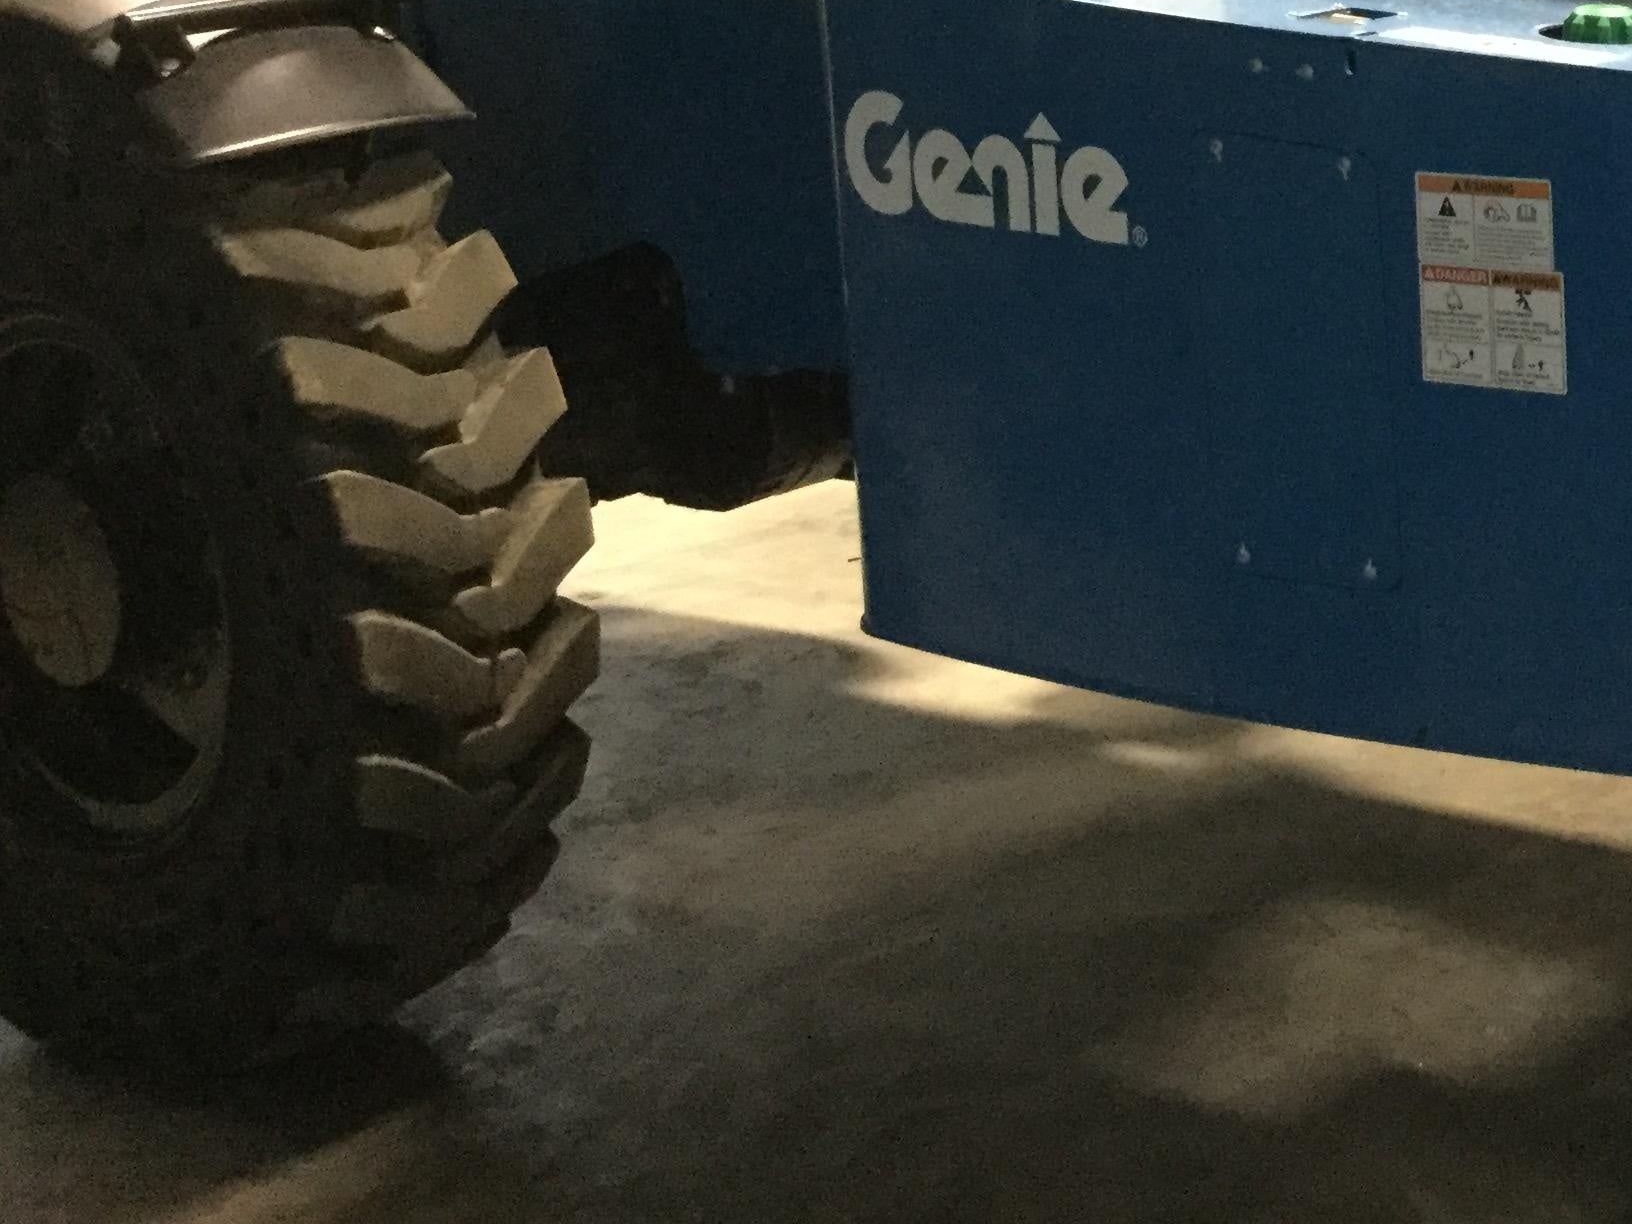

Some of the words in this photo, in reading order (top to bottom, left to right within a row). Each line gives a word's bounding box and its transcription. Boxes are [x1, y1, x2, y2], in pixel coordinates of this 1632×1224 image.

[845, 90, 1129, 245] Genie
[1463, 178, 1516, 195] WARNING
[1435, 267, 1487, 284] DANGER
